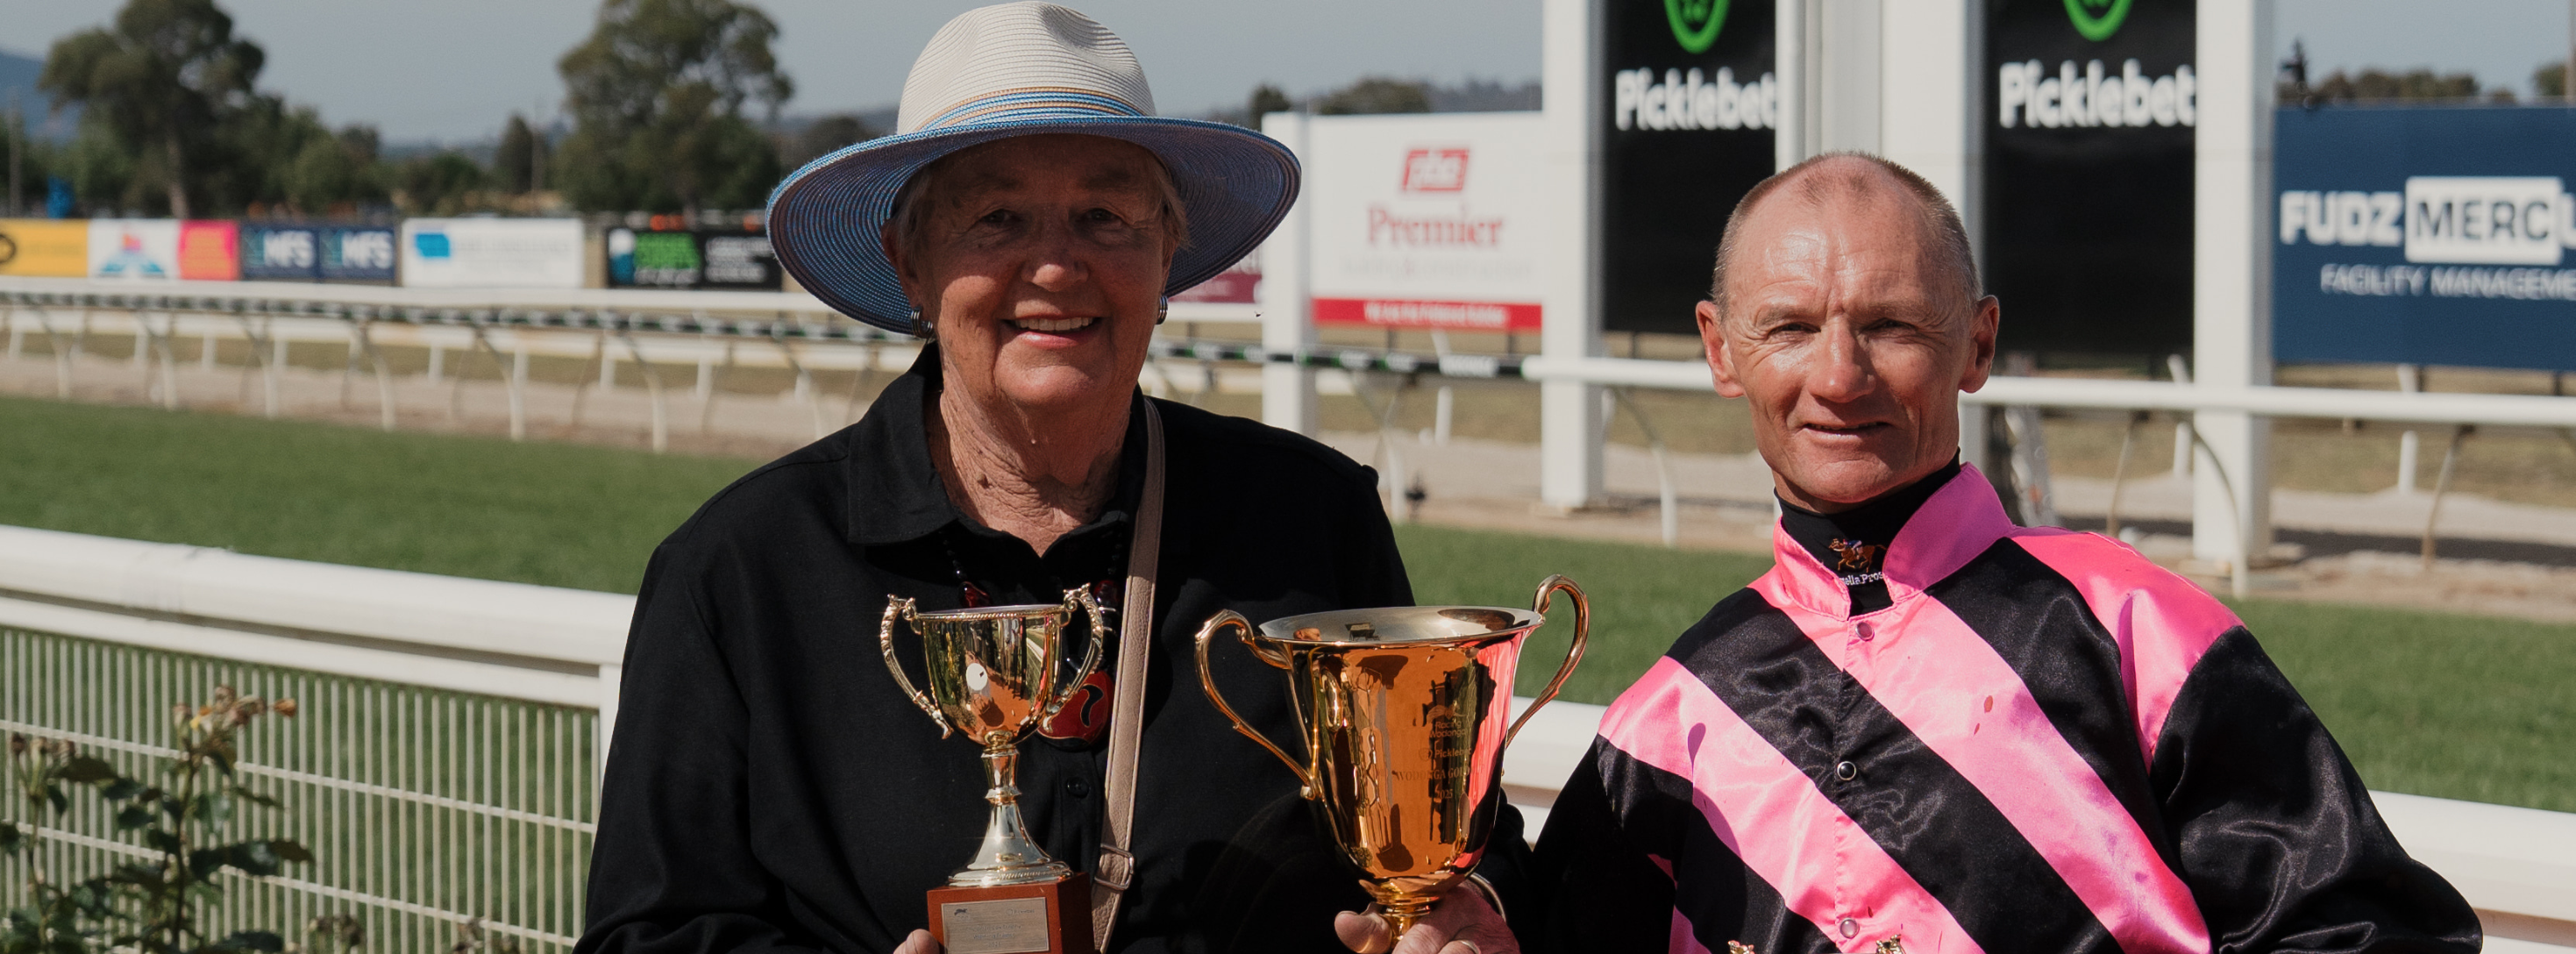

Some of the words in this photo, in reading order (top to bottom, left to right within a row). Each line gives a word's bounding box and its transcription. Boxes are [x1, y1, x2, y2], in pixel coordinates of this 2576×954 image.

[1616, 67, 1775, 131] Picklebet
[2000, 58, 2195, 128] Picklebet
[1367, 203, 1503, 247] Premier
[2280, 190, 2403, 246] FUDZ
[2416, 201, 2550, 240] MERC
[2321, 263, 2428, 297] FACILITY
[1434, 720, 1462, 730] Racing
